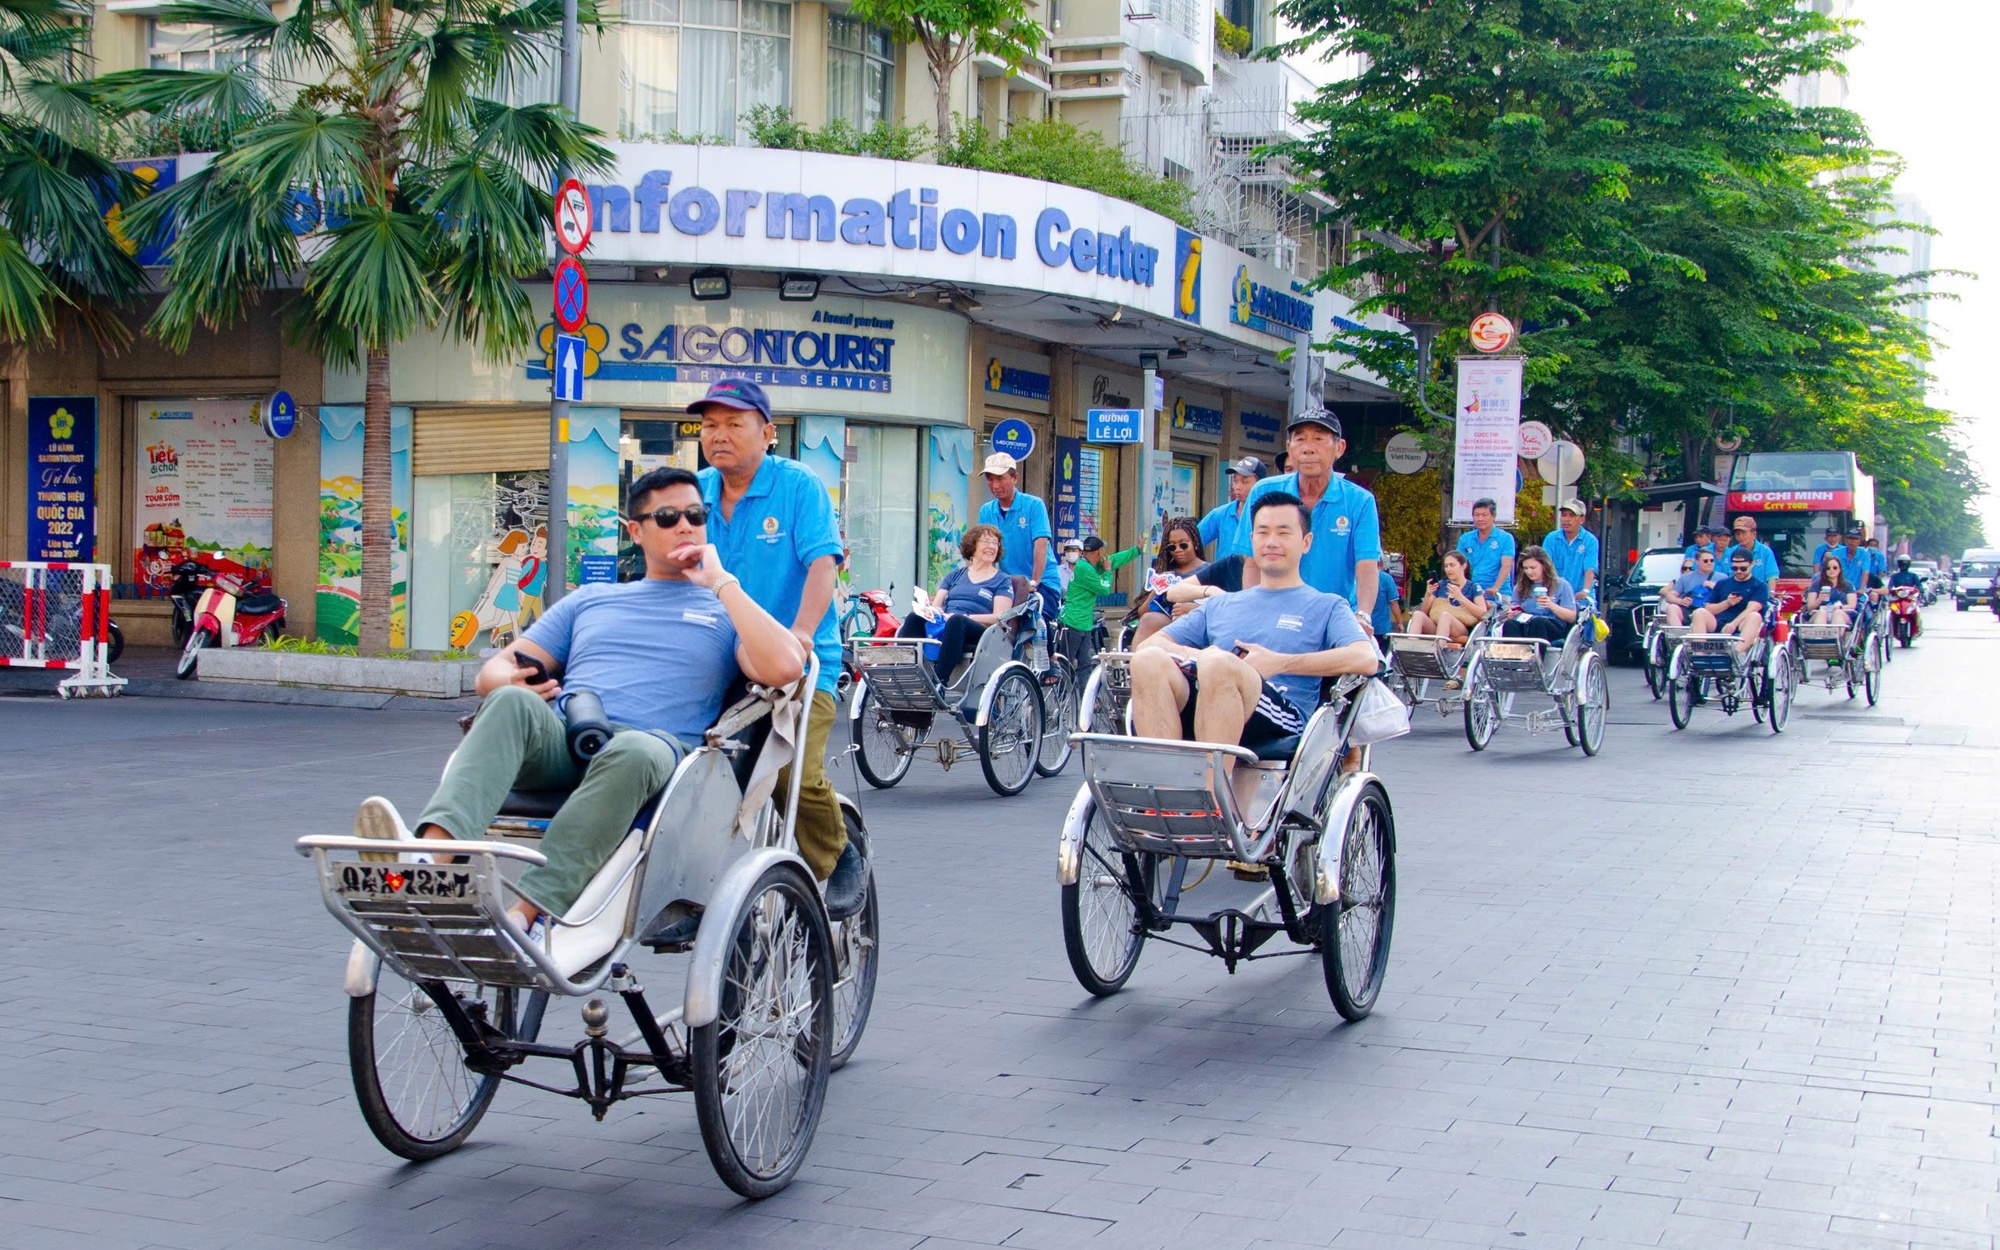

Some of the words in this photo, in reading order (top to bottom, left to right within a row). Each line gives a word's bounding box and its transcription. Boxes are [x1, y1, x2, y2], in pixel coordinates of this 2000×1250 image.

[553, 168, 1017, 260] nformation
[1035, 206, 1159, 287] Center
[620, 323, 895, 372] SAIGONTOURIST
[683, 369, 780, 385] TRAVEL
[799, 374, 889, 391] SERVICE
[682, 423, 702, 434] OP
[1096, 426, 1111, 438] LÊ
[1742, 493, 1763, 502] HO
[1766, 492, 1791, 501] CHI
[1794, 491, 1833, 501] MINH
[37, 503, 65, 520] QUỐC
[67, 506, 85, 520] GIA
[48, 521, 73, 535] 2022
